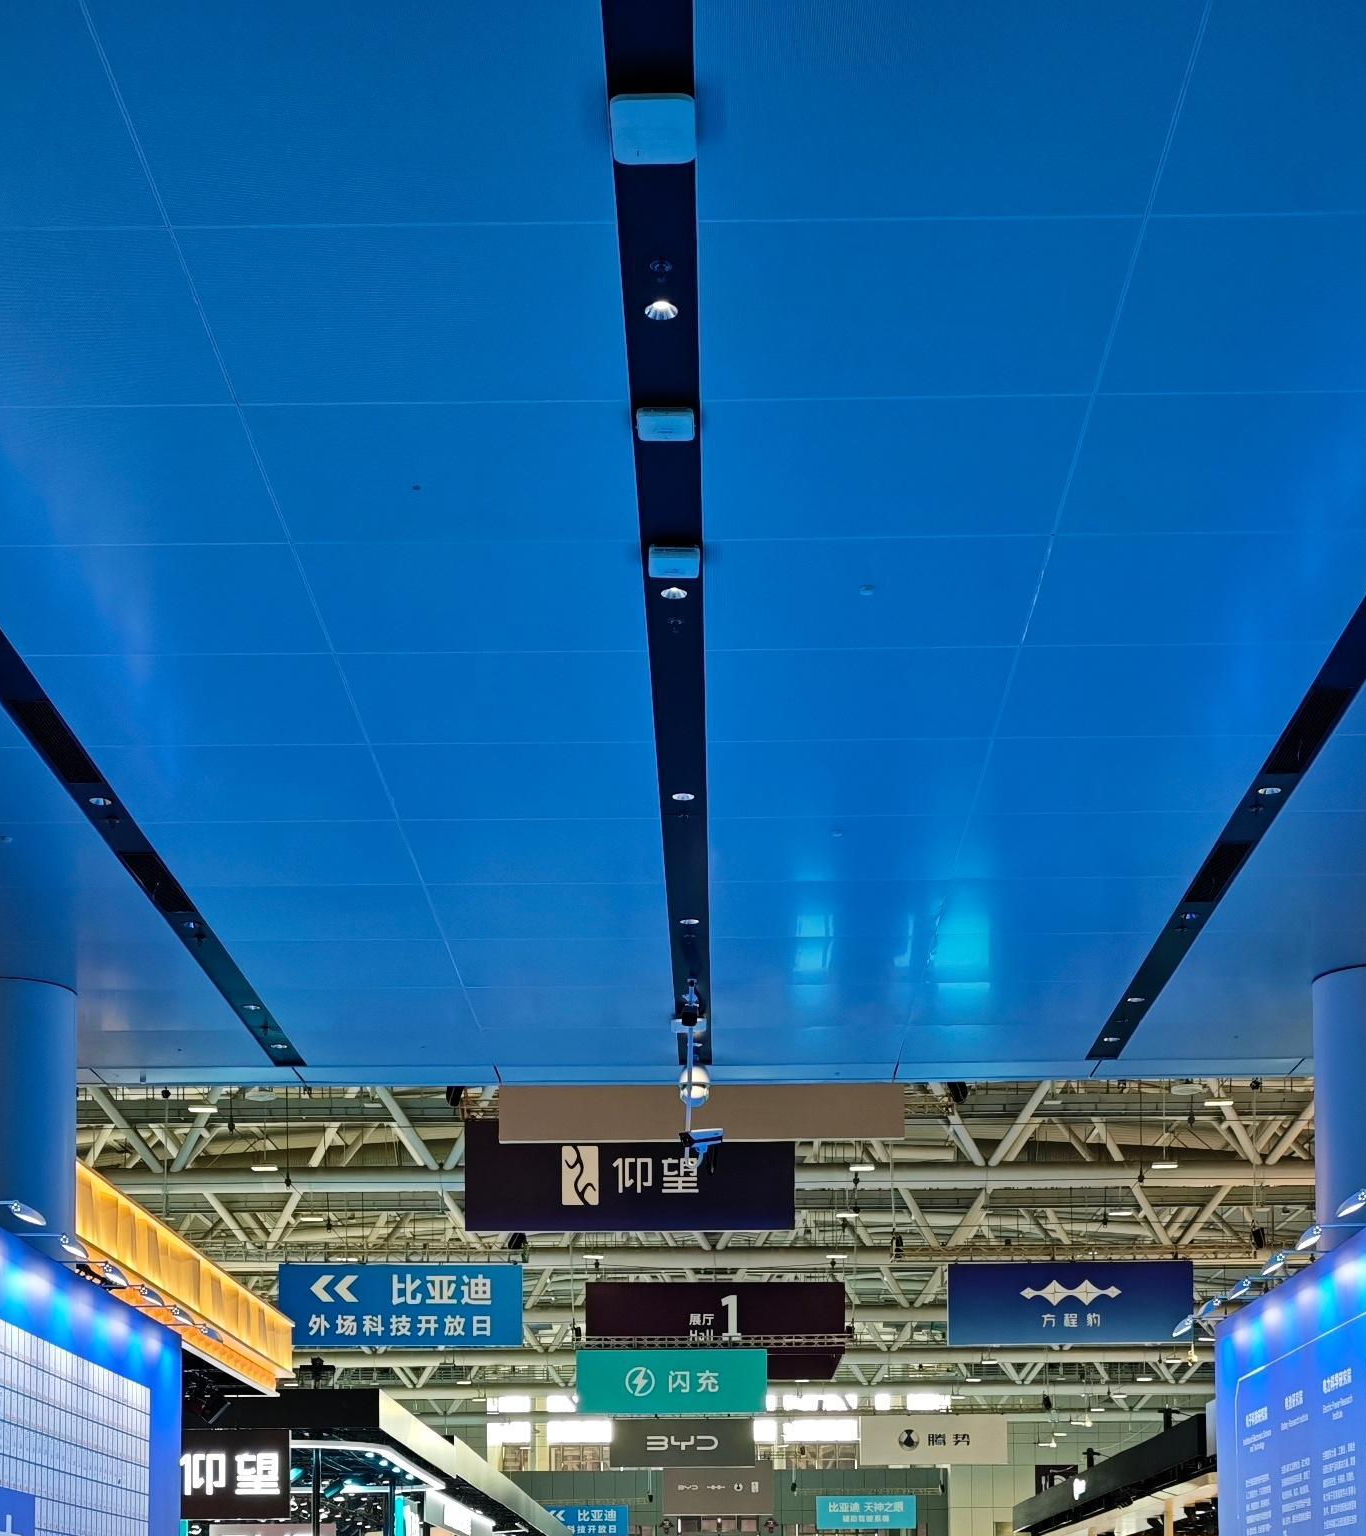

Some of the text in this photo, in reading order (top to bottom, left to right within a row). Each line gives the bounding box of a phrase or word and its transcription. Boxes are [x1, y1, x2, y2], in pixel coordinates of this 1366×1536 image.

[612, 1157, 699, 1194] 仰望
[391, 1274, 493, 1305] 比亚迪
[308, 1315, 493, 1337] 外场科技开放日
[689, 1314, 714, 1326] 展厅
[721, 1295, 742, 1341] 1
[1042, 1312, 1102, 1328] 方程豹
[689, 1329, 714, 1342] Hall
[668, 1370, 719, 1393] 闪充
[647, 1435, 718, 1450] BYD
[928, 1434, 970, 1446] 腾势
[179, 1453, 280, 1495] 仰望
[829, 1501, 860, 1512] 比亚迪
[578, 1509, 617, 1521] 比亚迪
